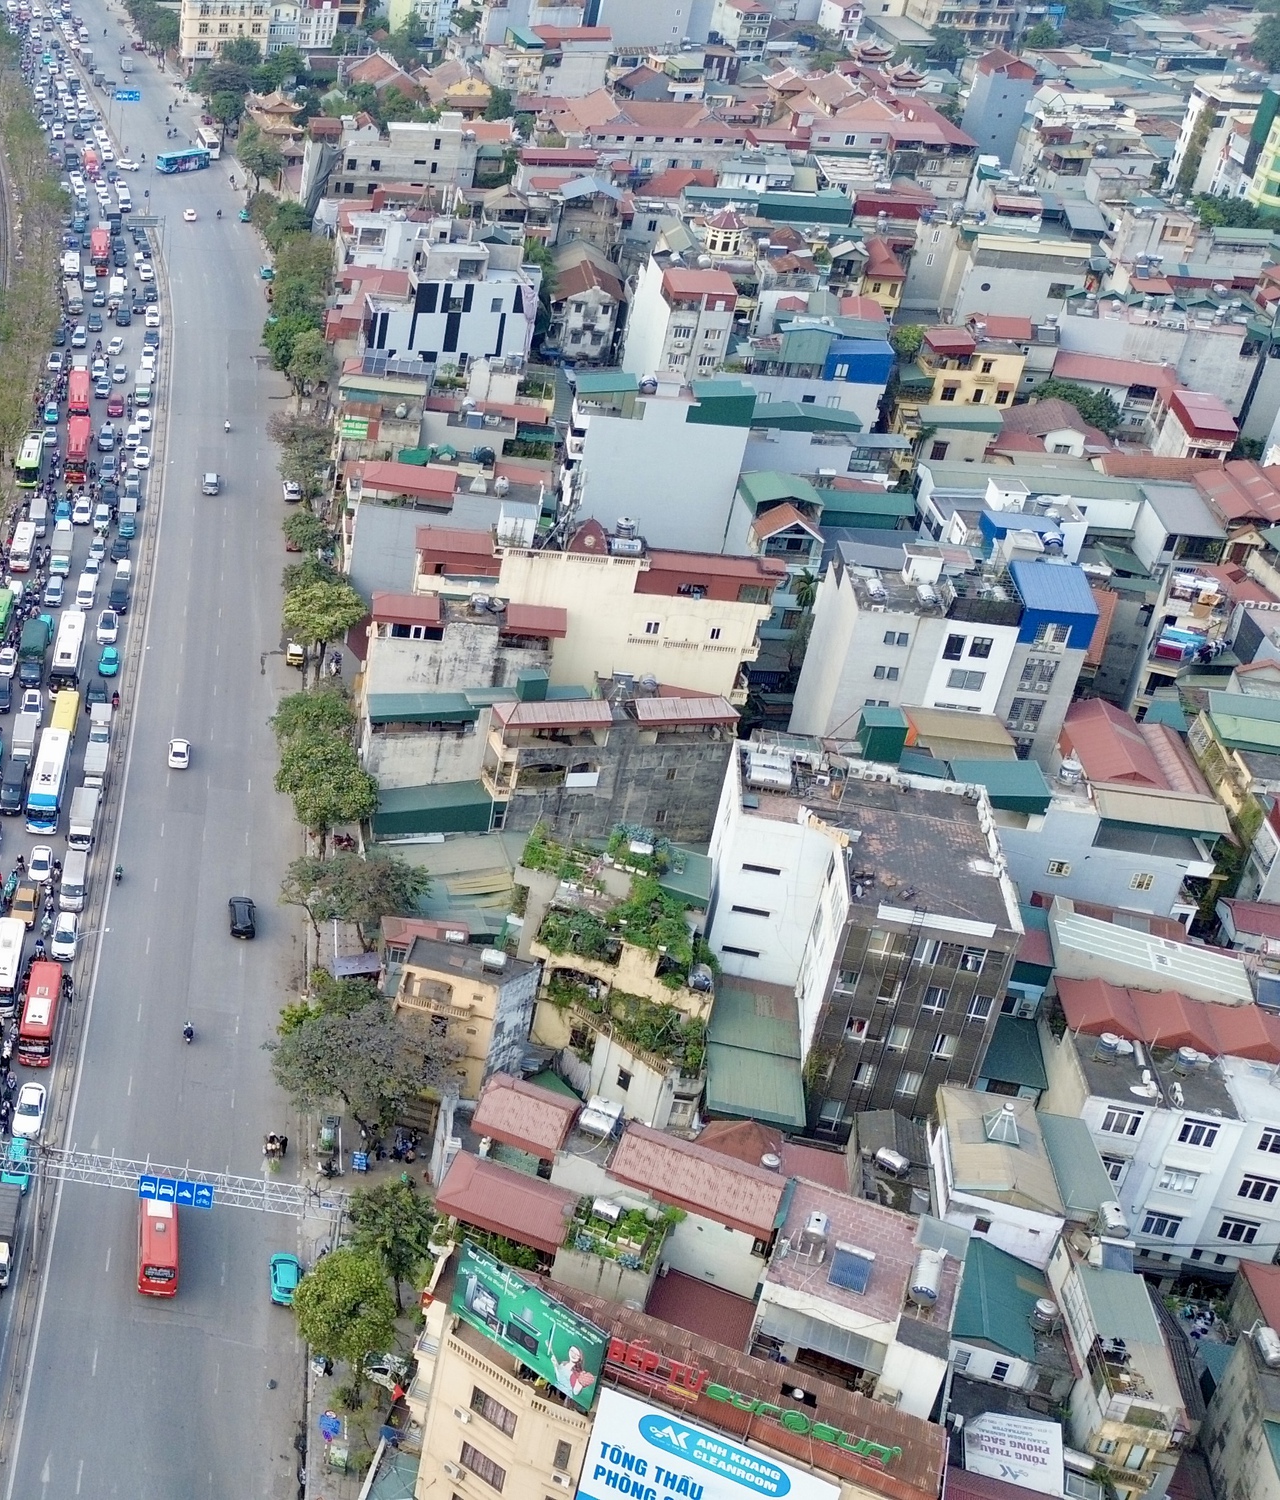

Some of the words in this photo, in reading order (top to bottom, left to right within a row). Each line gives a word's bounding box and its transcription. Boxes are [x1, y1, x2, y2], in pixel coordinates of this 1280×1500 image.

[608, 1337, 659, 1374] BẾP
[667, 1357, 709, 1392] TỪ
[600, 1441, 648, 1477] TỔNG
[654, 1465, 705, 1500] THẦU
[693, 1451, 778, 1493] CLEANROOM
[696, 1438, 728, 1457] ANH
[730, 1452, 782, 1481] KHANG
[593, 1464, 657, 1500] PHÒNG
